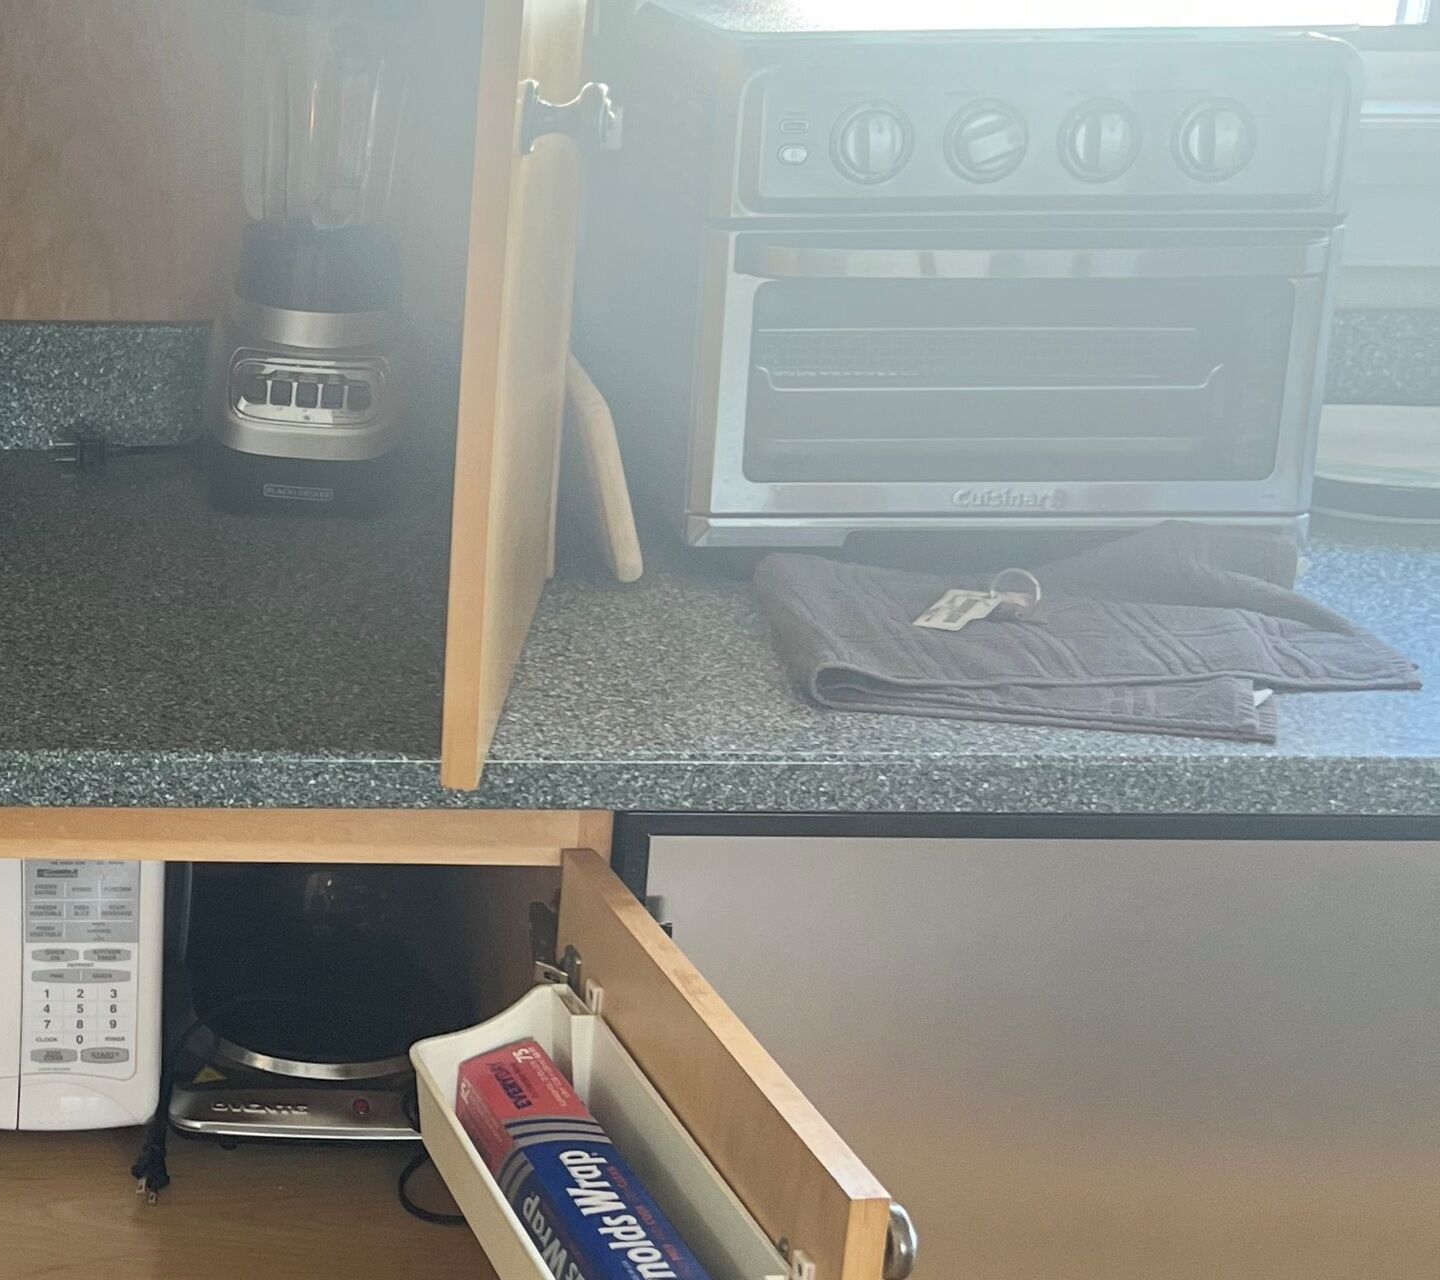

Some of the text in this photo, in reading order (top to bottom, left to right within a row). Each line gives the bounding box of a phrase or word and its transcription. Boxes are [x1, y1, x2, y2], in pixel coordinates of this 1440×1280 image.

[952, 488, 1062, 508] Cuisinart
[44, 989, 49, 998] 1
[76, 989, 85, 998] 2
[110, 989, 118, 998] 3
[43, 1004, 50, 1013] 4
[76, 1004, 84, 1013] 5
[109, 1004, 117, 1013] 6
[43, 1020, 51, 1029] 7
[76, 1019, 84, 1029] 8
[109, 1019, 117, 1029] 9
[75, 1034, 84, 1045] 0
[511, 1046, 533, 1064] 75
[559, 1149, 626, 1217] Wrap
[521, 1192, 567, 1276] Wrap
